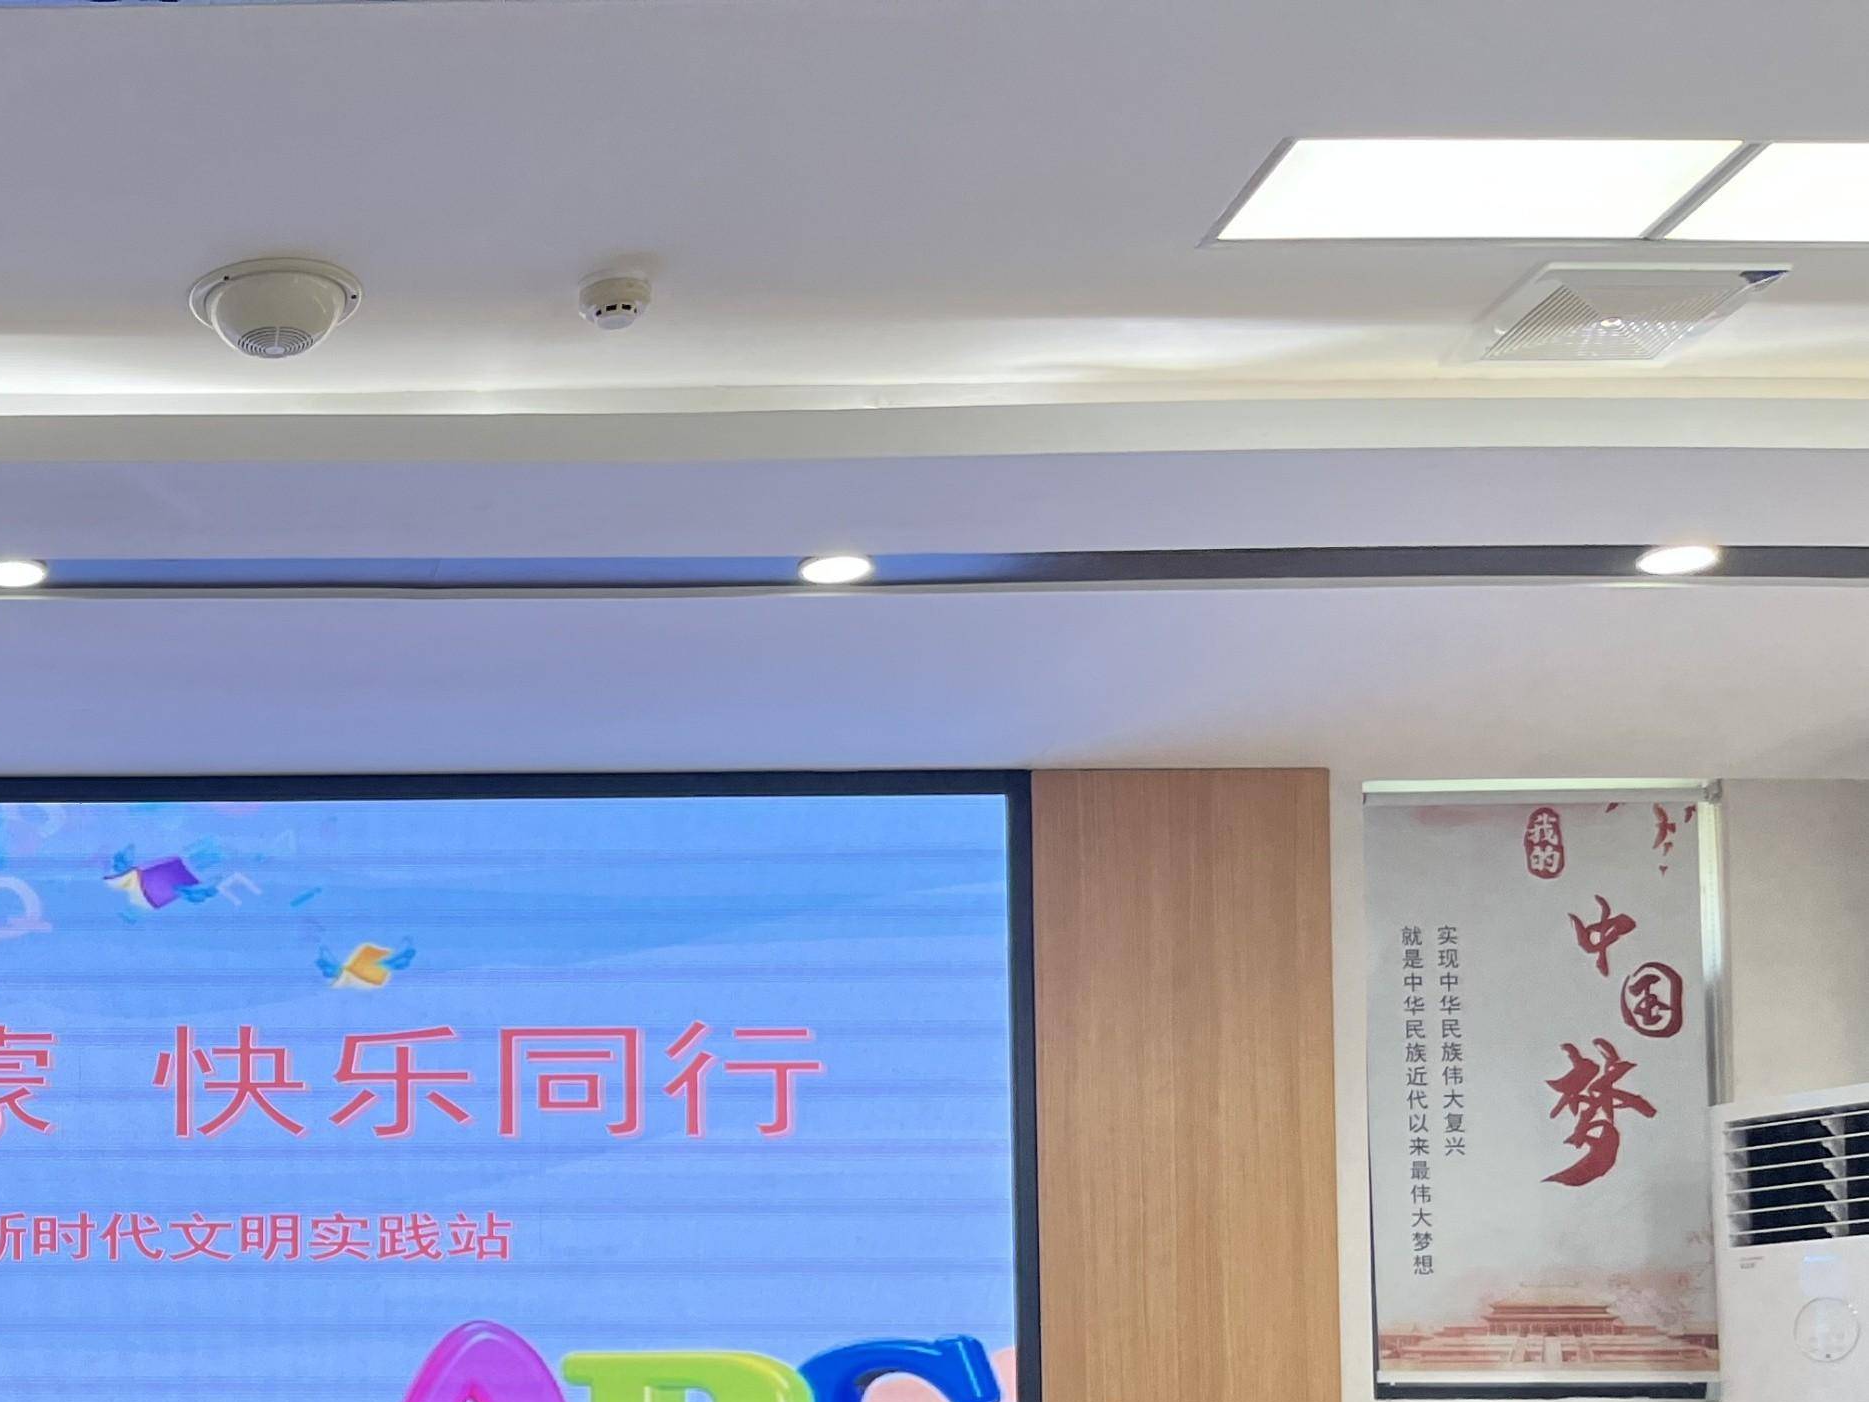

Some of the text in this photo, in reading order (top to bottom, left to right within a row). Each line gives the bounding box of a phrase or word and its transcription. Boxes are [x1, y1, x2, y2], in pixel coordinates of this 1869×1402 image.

[1527, 811, 1561, 873] 我的
[152, 1020, 825, 1139] 快乐同行
[1401, 925, 1434, 1276] 就是中华民族近代以来最伟大梦想
[1436, 925, 1466, 1158] 实现中华民族伟大复兴
[1540, 894, 1683, 1188] 中国梦
